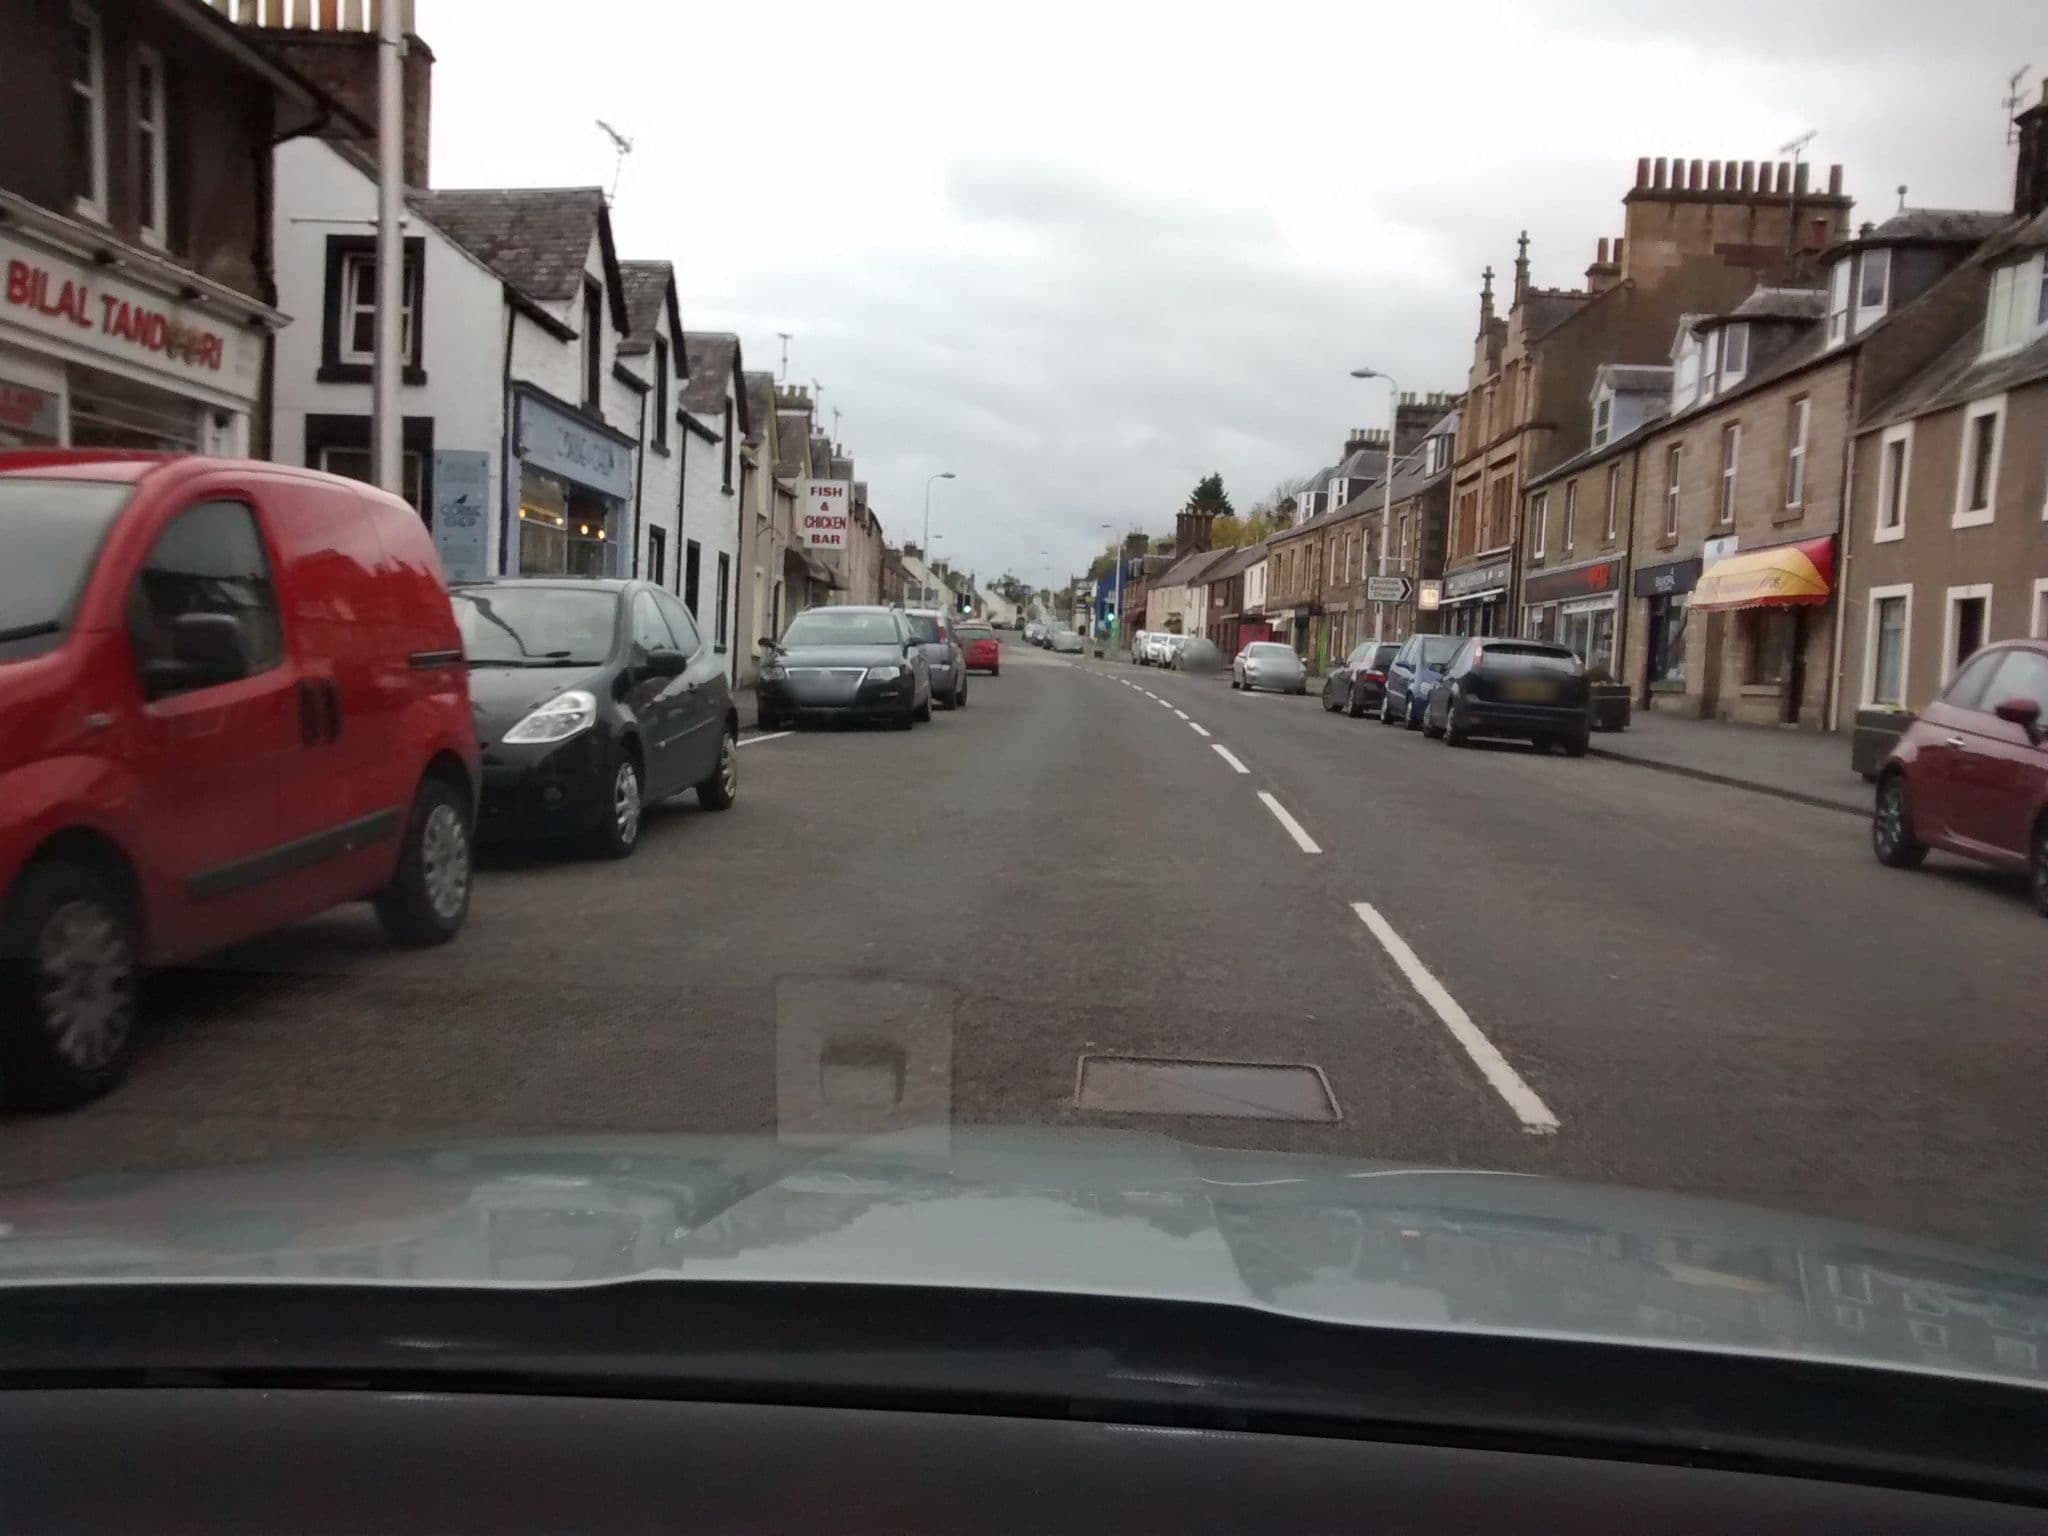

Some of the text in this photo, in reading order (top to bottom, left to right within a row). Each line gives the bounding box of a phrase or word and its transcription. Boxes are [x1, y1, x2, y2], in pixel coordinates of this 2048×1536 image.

[6, 258, 93, 327] BILAL
[810, 486, 843, 498] FISH
[820, 501, 830, 512] &
[804, 515, 847, 530] CHICKEN
[811, 534, 841, 545] BAR
